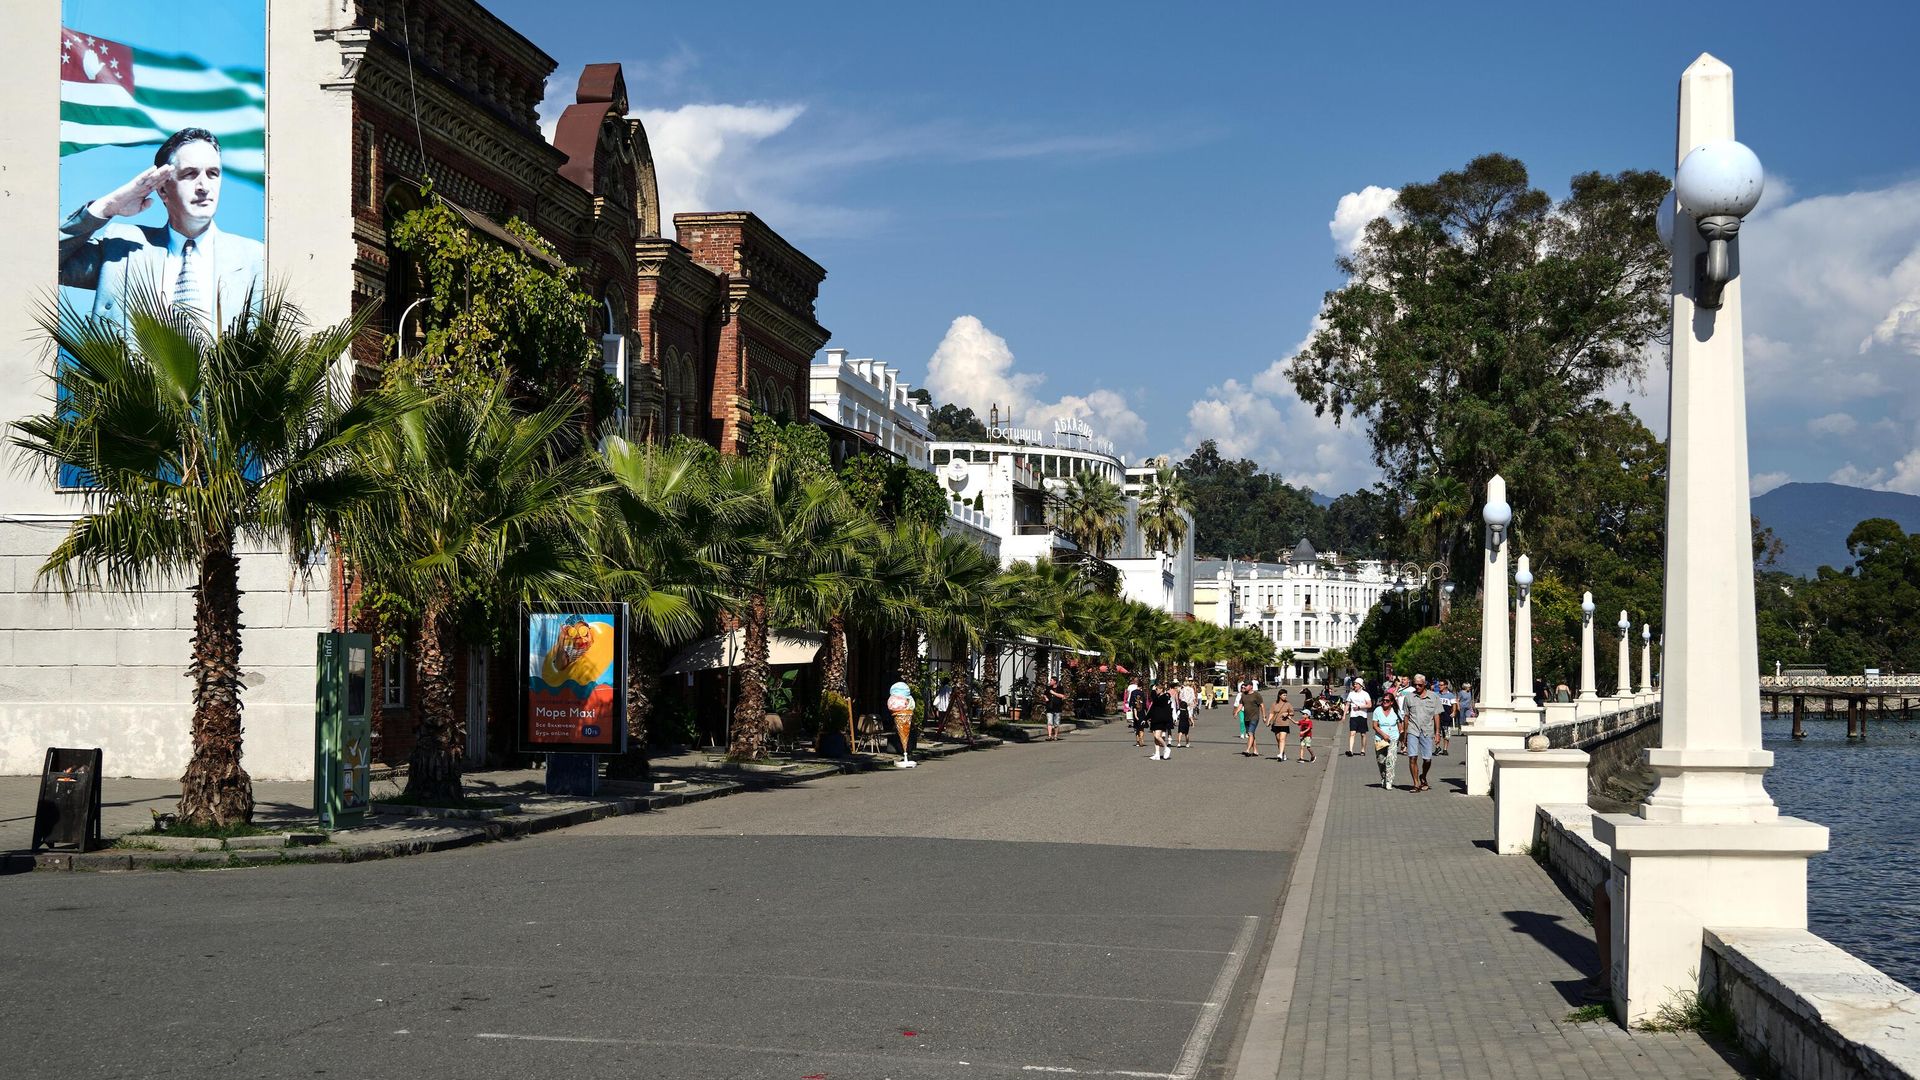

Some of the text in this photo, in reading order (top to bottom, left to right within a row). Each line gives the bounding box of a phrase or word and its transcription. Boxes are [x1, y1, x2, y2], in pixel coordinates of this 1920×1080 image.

[986, 417, 1094, 442] ГОСТИНИЦА АБХАЗИЯ
[324, 639, 332, 657] info
[536, 707, 595, 719] Море Maxi
